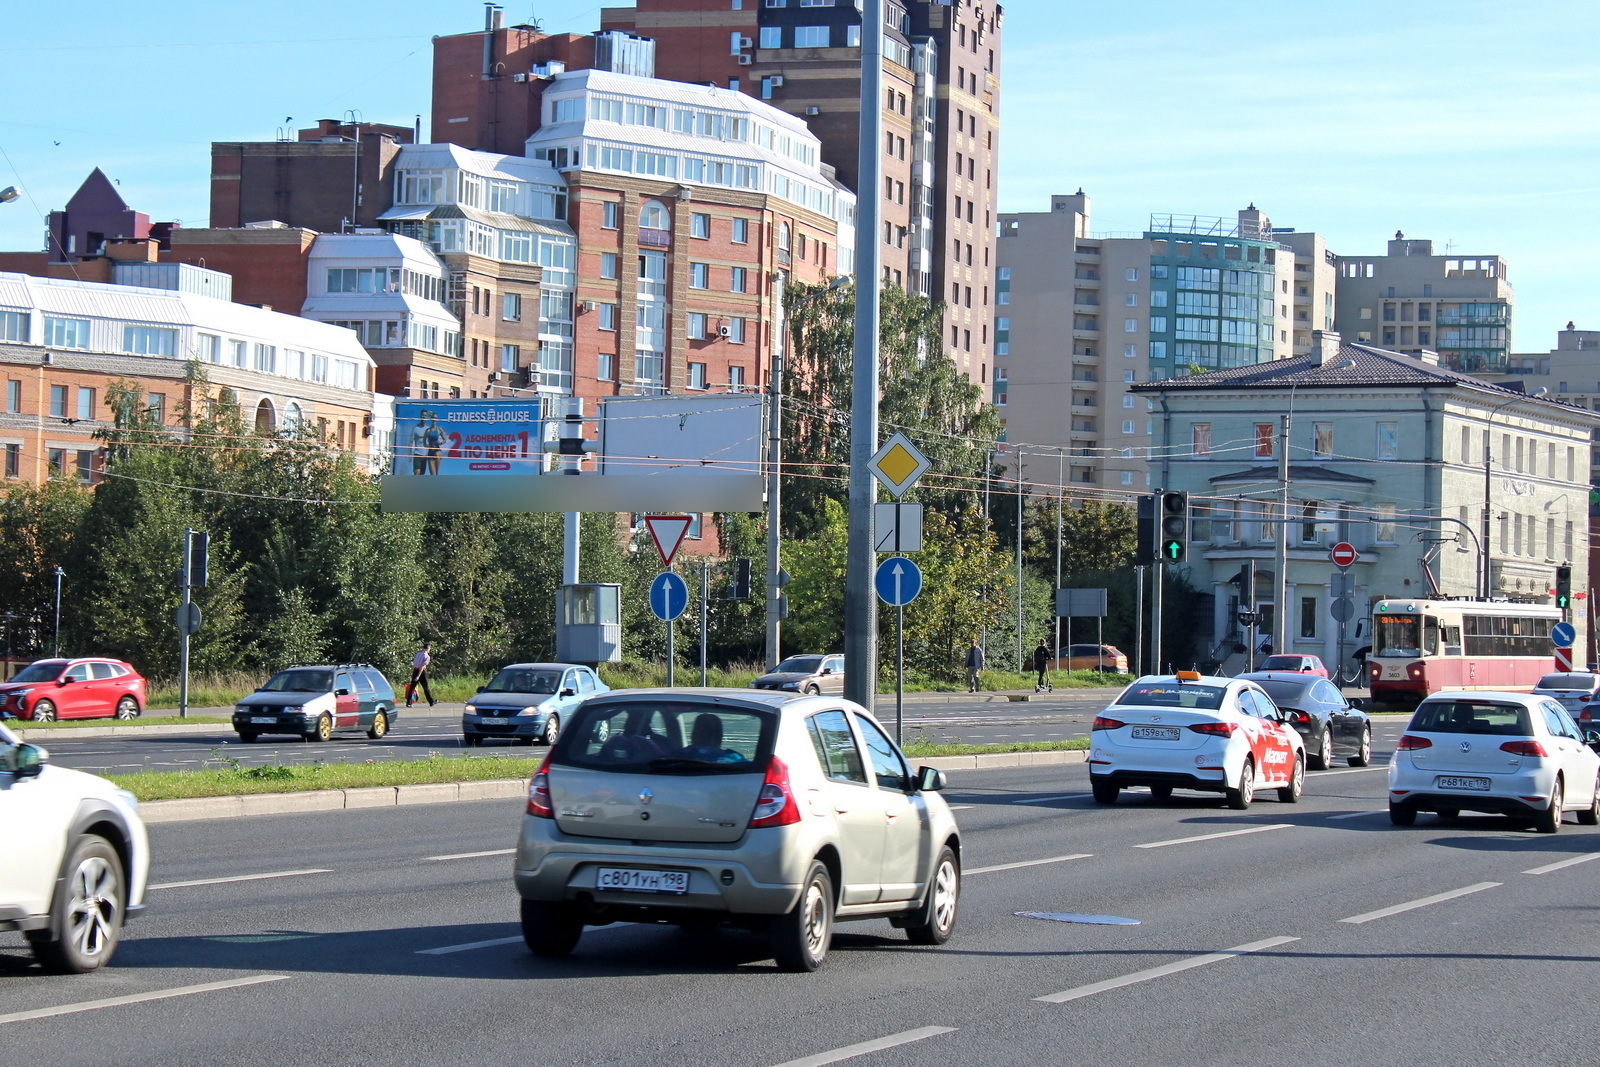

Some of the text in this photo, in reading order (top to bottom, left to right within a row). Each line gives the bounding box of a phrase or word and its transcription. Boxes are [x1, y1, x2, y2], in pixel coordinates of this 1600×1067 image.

[447, 410, 530, 423] FITNESS HOUSE
[447, 430, 529, 458] 2 АБОНЕМЕНТА 1
[464, 445, 517, 459] ПО ЦЕНЕ
[1263, 747, 1288, 766] Маркет
[662, 873, 685, 885] 198
